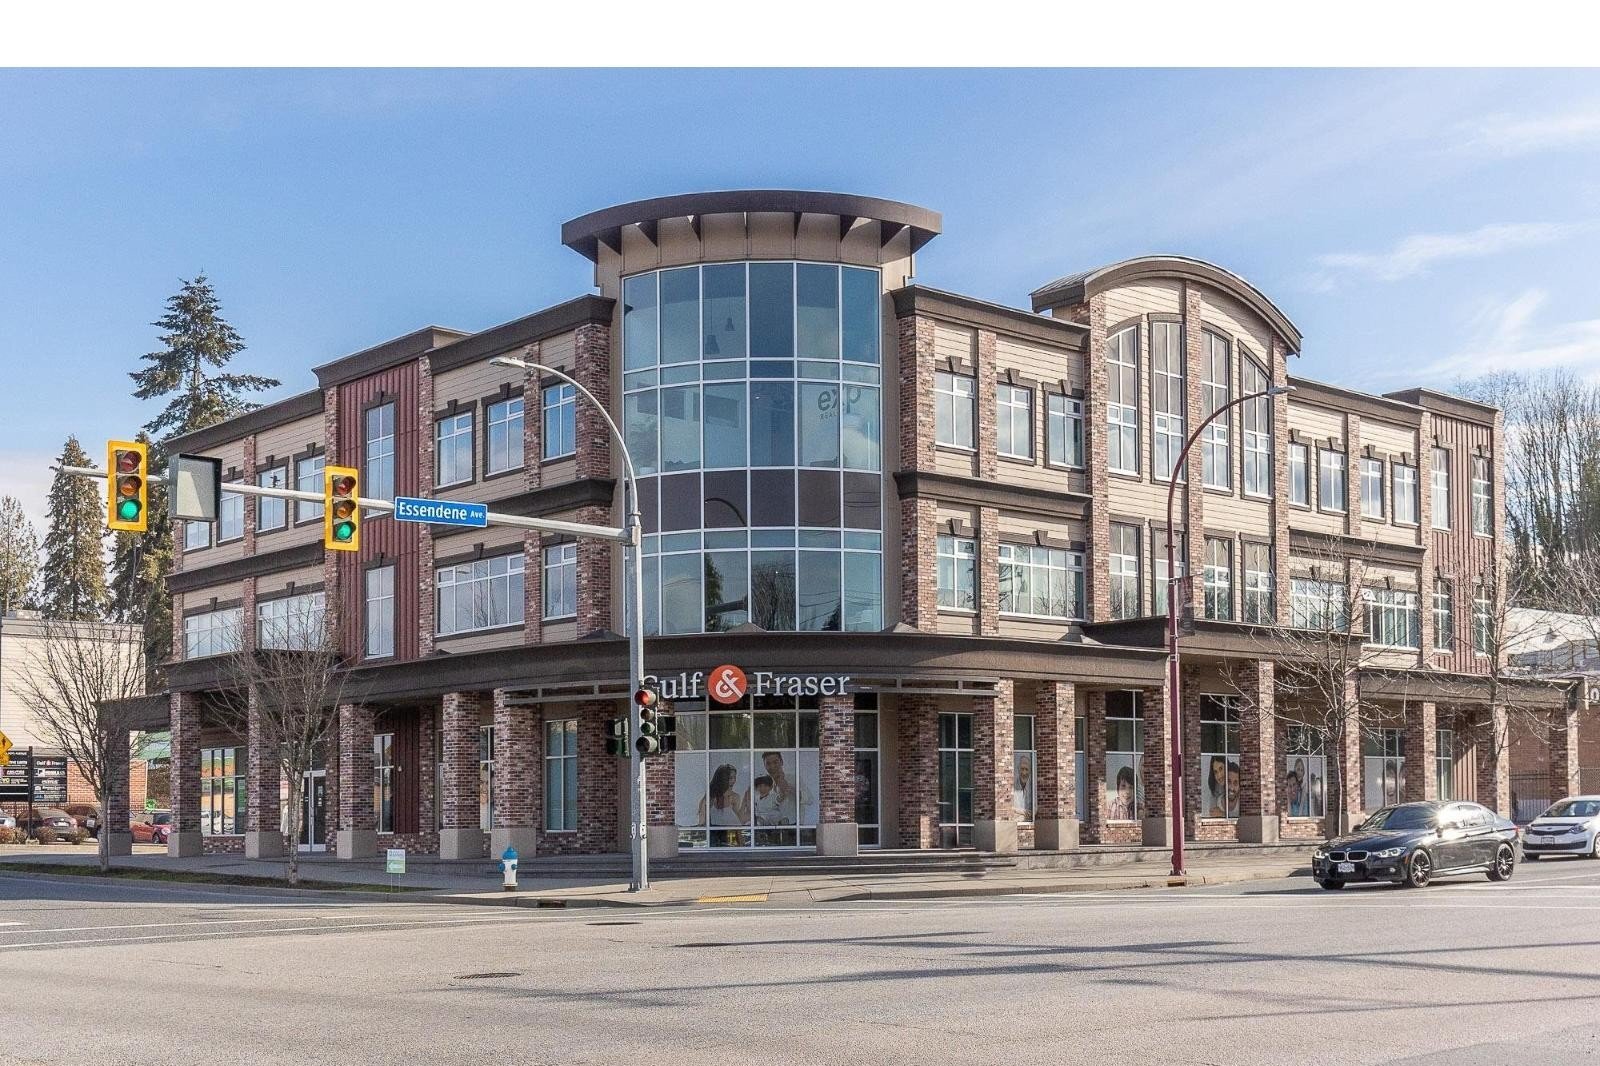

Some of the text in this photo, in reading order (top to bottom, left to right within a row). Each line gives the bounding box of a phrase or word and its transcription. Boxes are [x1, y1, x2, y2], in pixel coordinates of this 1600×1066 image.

[399, 501, 485, 521] Essendene Ave.
[753, 671, 850, 697] Fraser
